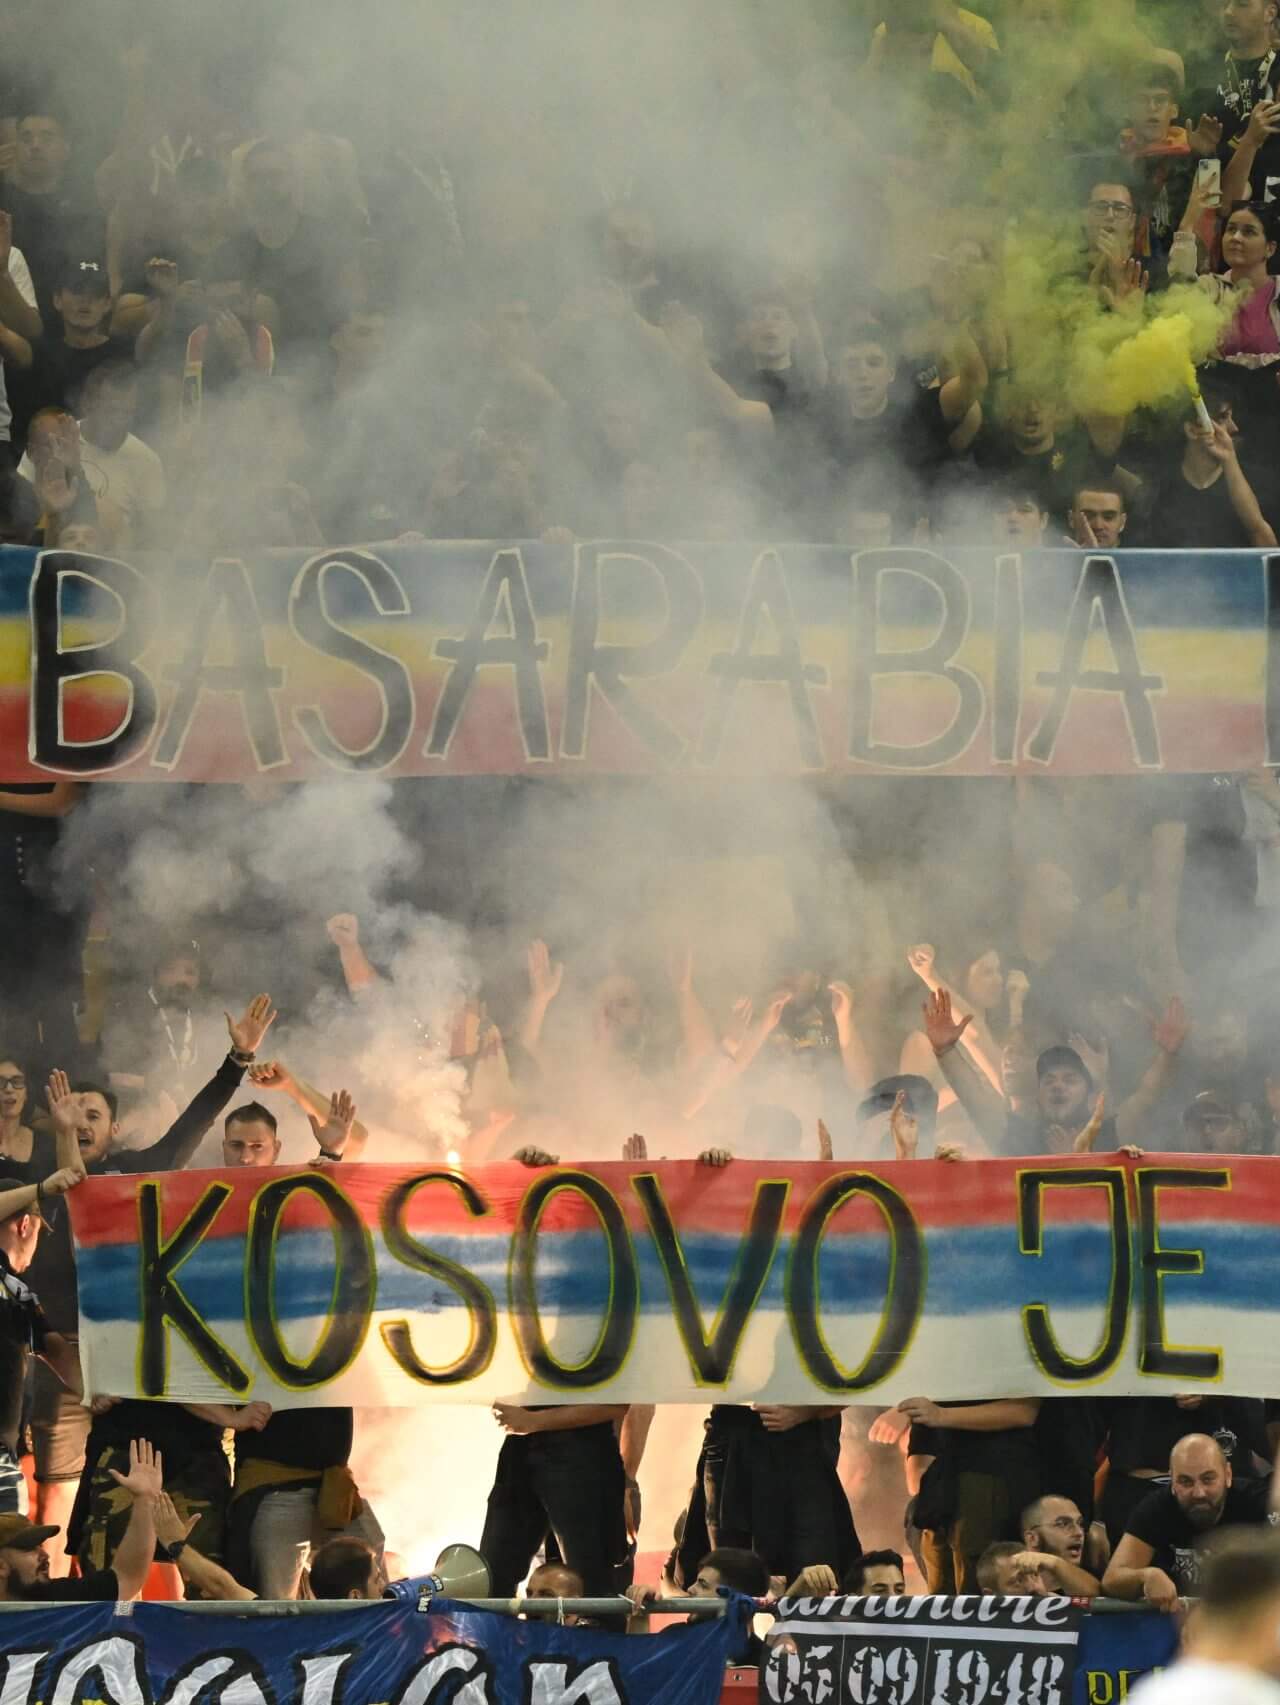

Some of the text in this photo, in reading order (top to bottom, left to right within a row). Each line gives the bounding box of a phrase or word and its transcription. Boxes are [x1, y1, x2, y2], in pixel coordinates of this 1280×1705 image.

[28, 540, 1165, 774] BASARABIA
[137, 1168, 928, 1399] KOSOVO
[1016, 1165, 1231, 1387] JE
[764, 1643, 835, 1705] 05
[847, 1645, 919, 1705] 09
[930, 1648, 1066, 1705] 1948
